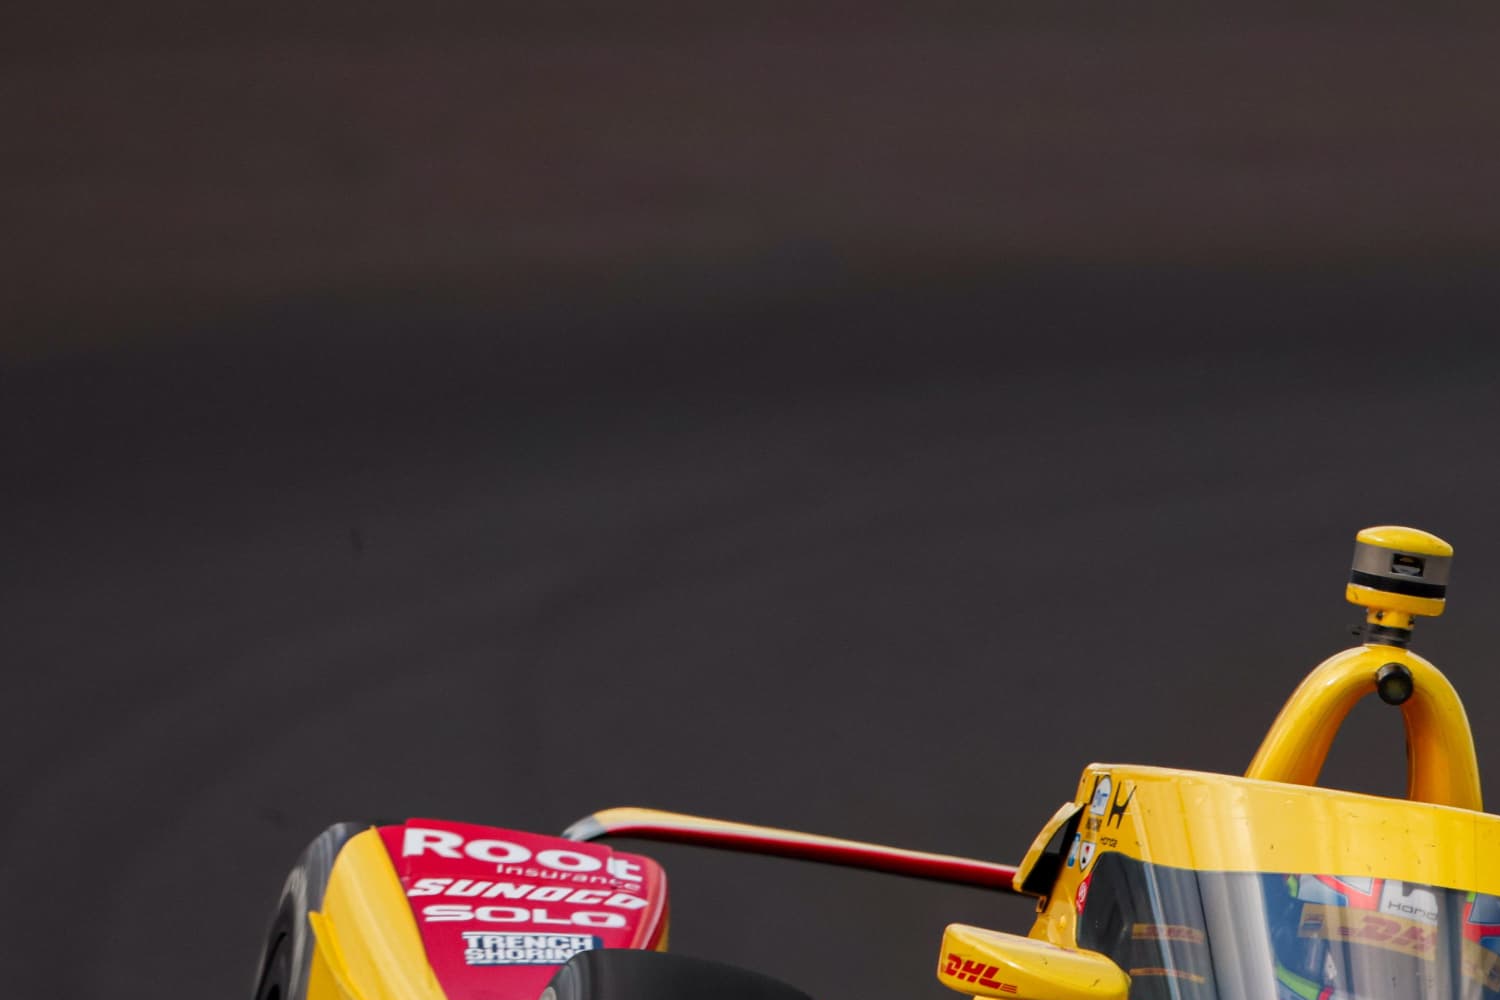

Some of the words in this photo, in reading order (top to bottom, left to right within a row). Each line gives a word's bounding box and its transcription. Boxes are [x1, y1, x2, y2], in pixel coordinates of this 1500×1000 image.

[407, 878, 649, 909] SUNOCO
[422, 904, 626, 928] SOLO
[466, 935, 593, 950] TRENCH
[464, 949, 585, 961] SHORIN
[944, 953, 1003, 989] DHL
